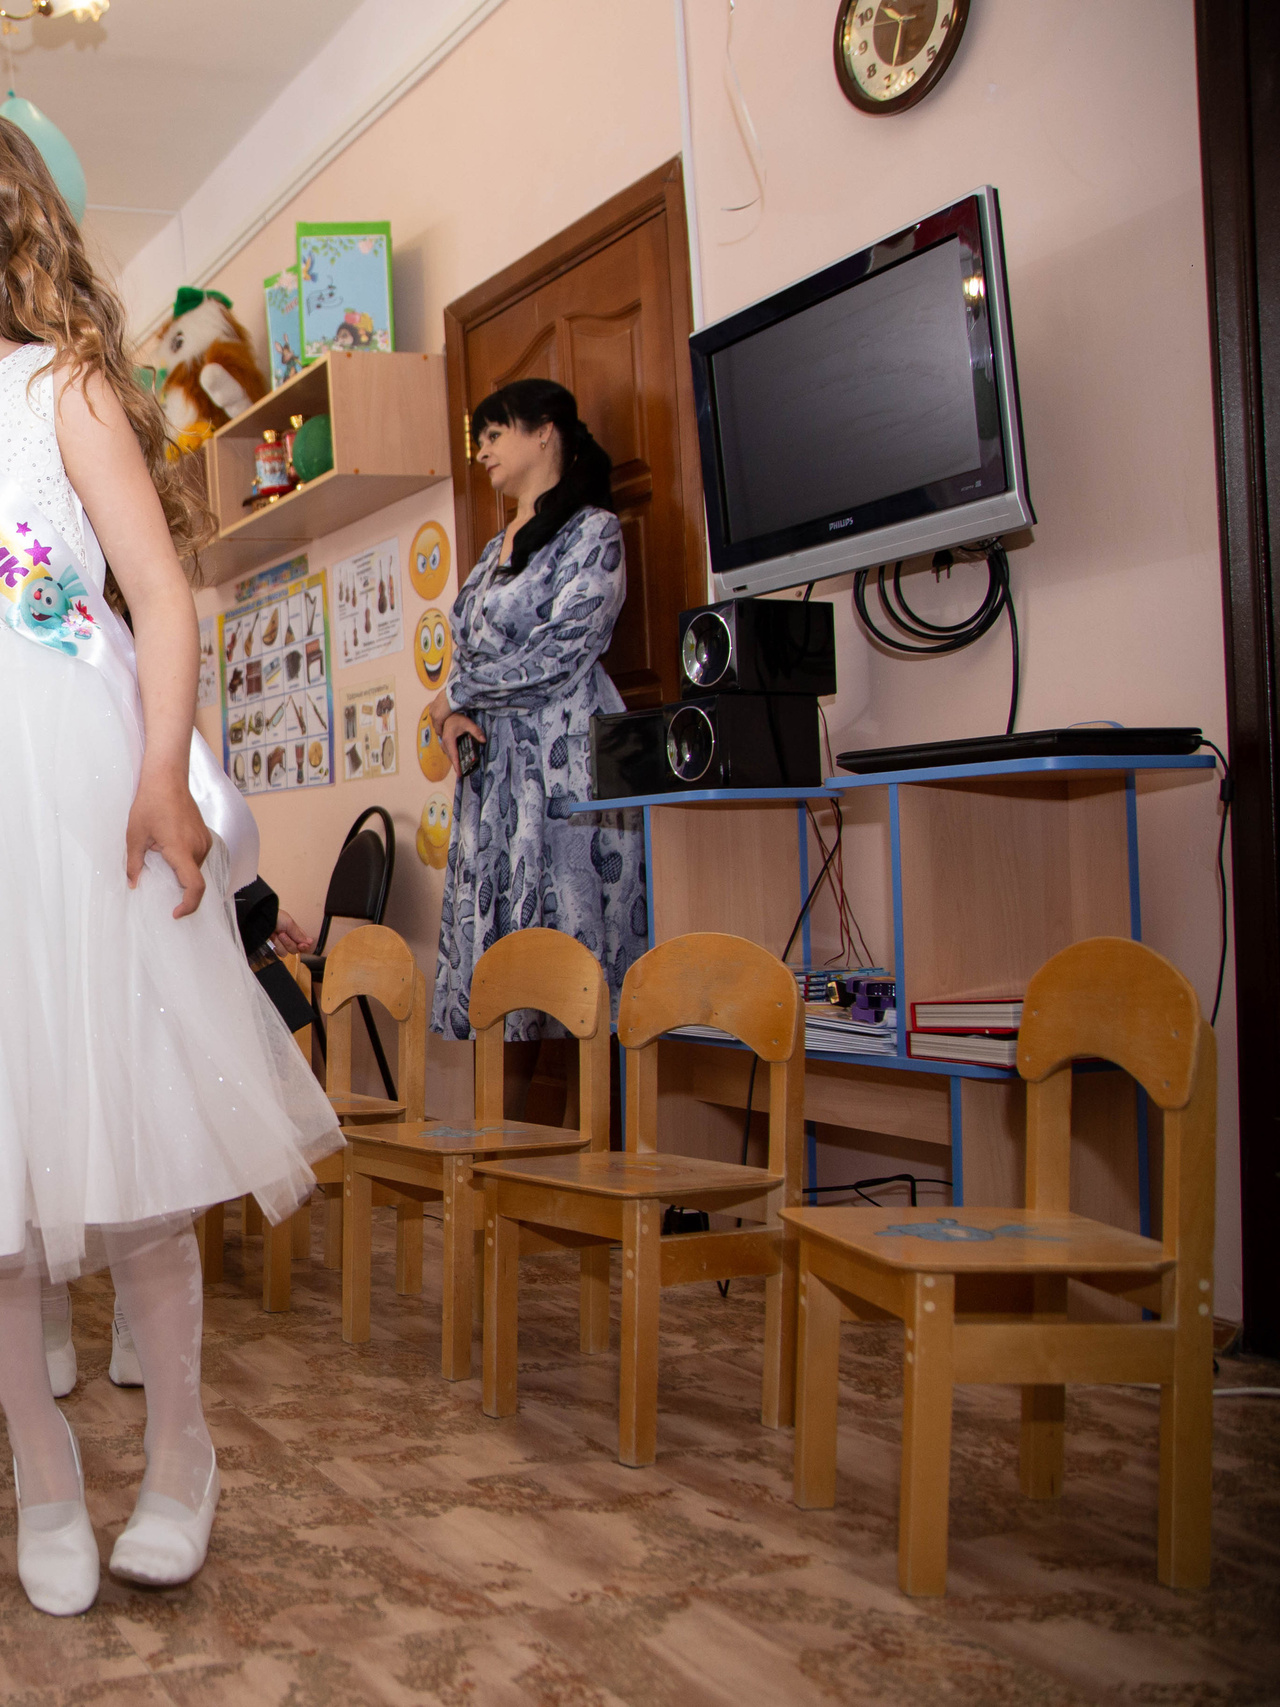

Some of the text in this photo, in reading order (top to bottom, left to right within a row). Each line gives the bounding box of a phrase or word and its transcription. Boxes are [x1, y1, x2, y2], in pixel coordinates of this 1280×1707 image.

[857, 7, 873, 27] 10
[940, 13, 950, 30] 4
[858, 40, 868, 55] 9
[926, 45, 937, 62] 5
[866, 63, 877, 79] 8
[829, 516, 854, 531] PHILIPS
